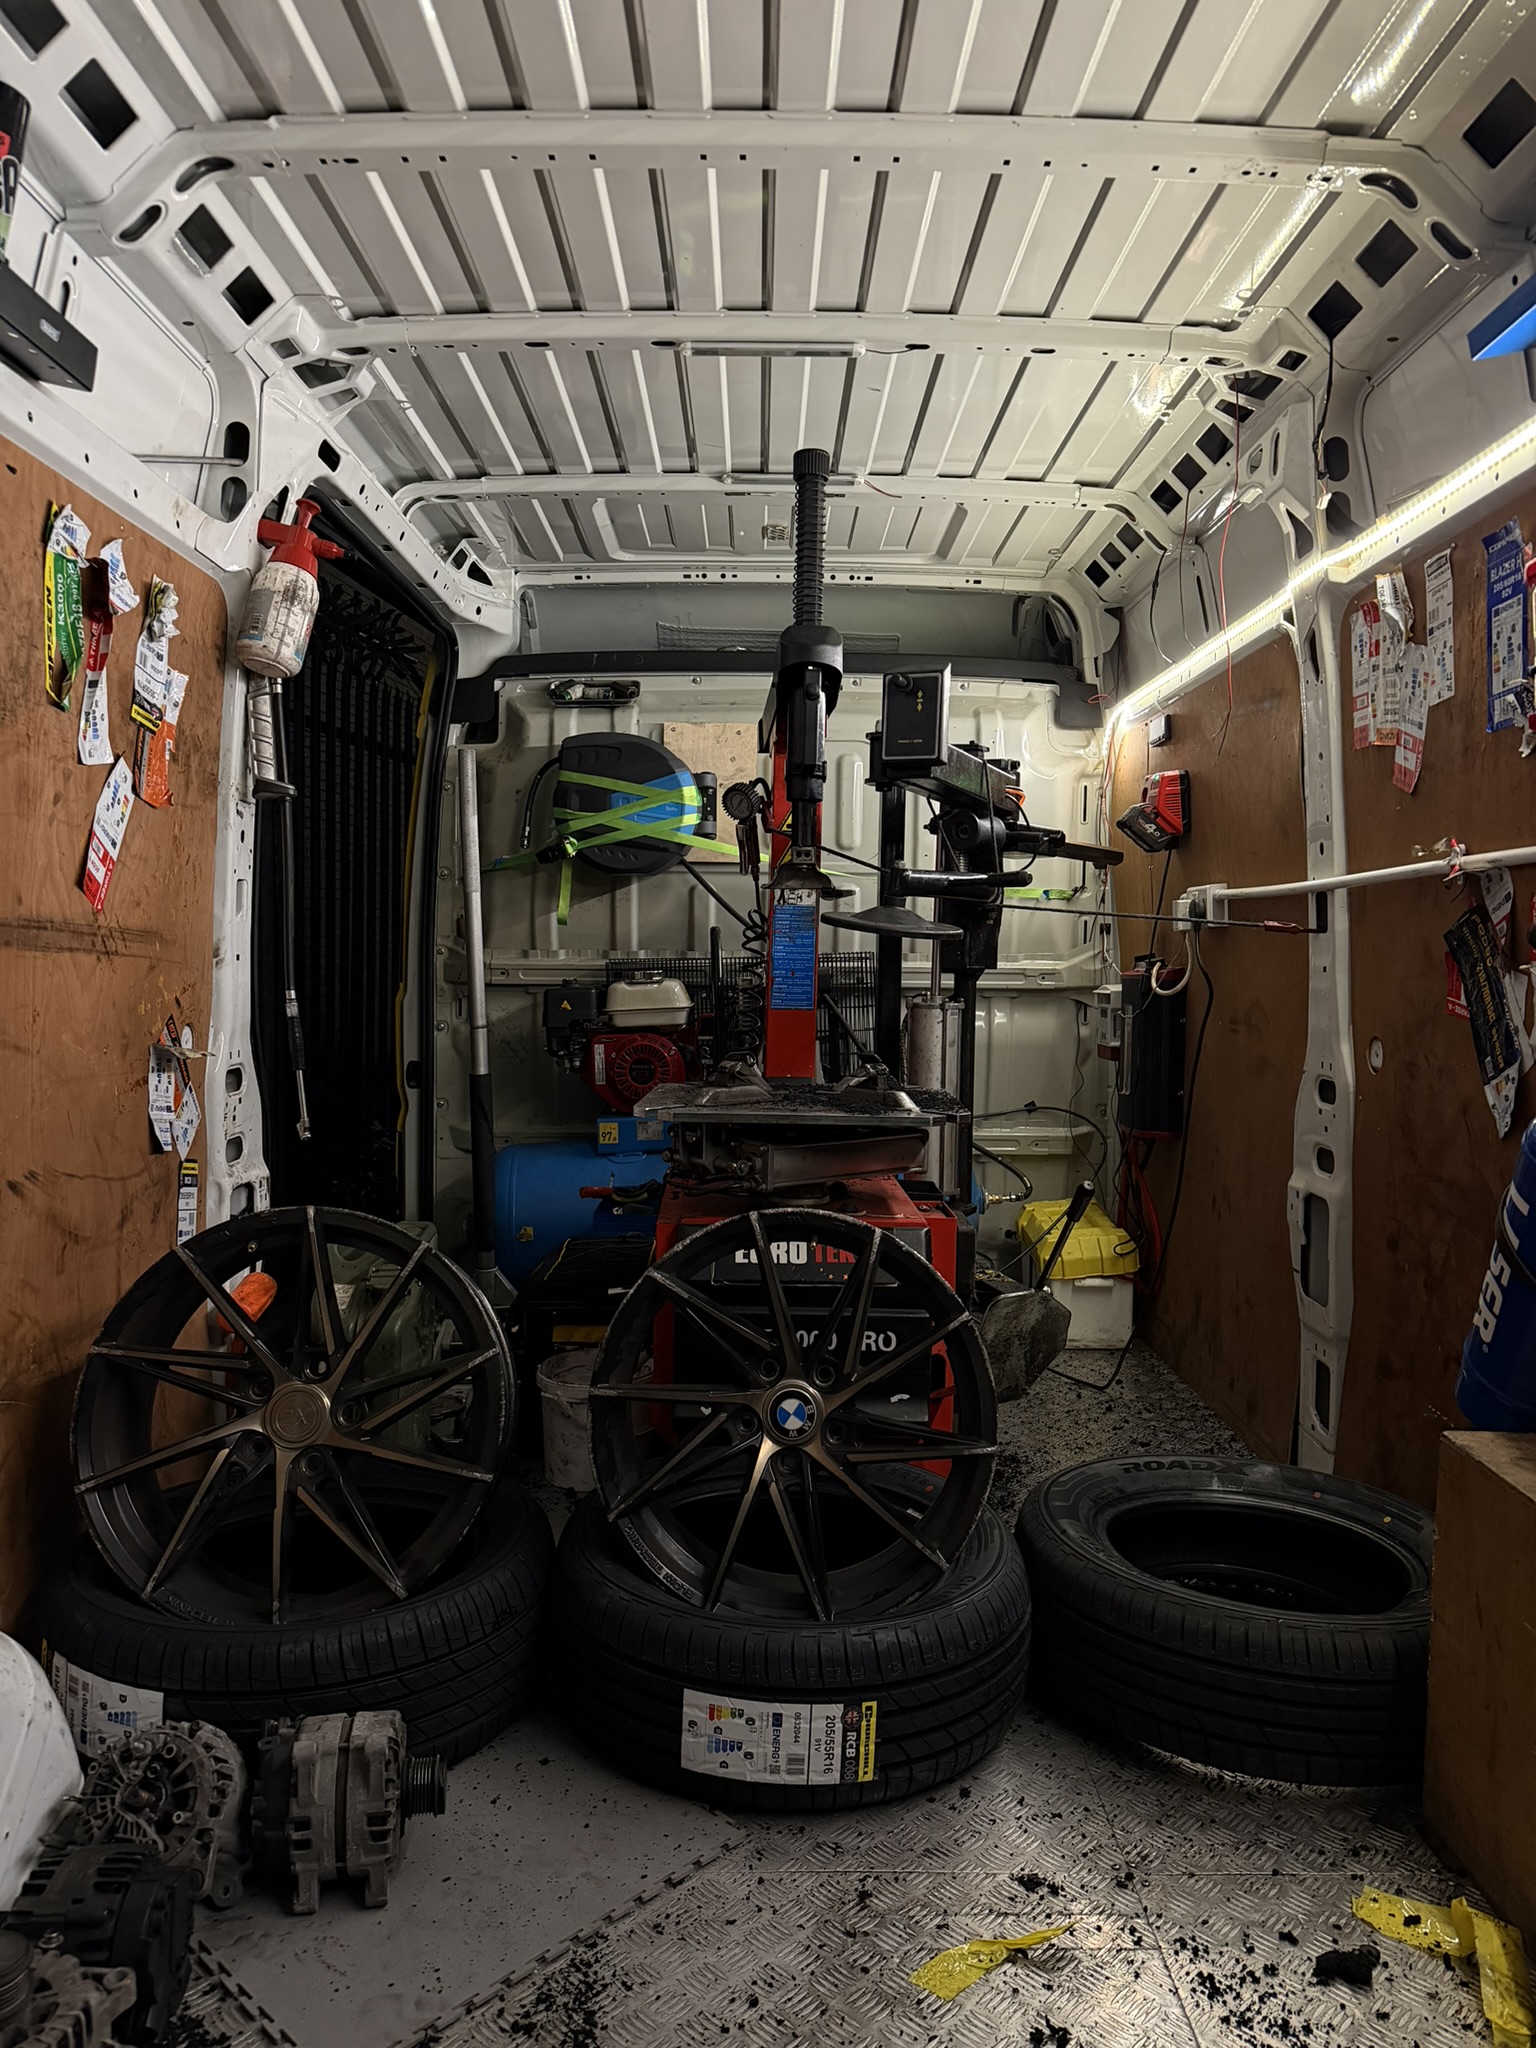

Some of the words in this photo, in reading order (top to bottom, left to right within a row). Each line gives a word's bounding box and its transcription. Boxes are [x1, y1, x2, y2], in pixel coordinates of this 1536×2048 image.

[1490, 562, 1515, 582] BLAZER
[57, 573, 66, 626] K3000
[601, 1131, 612, 1142] 97
[788, 1404, 815, 1438] BMW
[1117, 1459, 1260, 1477] ROADX
[771, 1728, 781, 1760] ENERG
[814, 1738, 822, 1753] 91V
[823, 1714, 837, 1775] 205/55R16
[846, 1731, 856, 1758] RCB
[844, 1759, 855, 1782] 008
